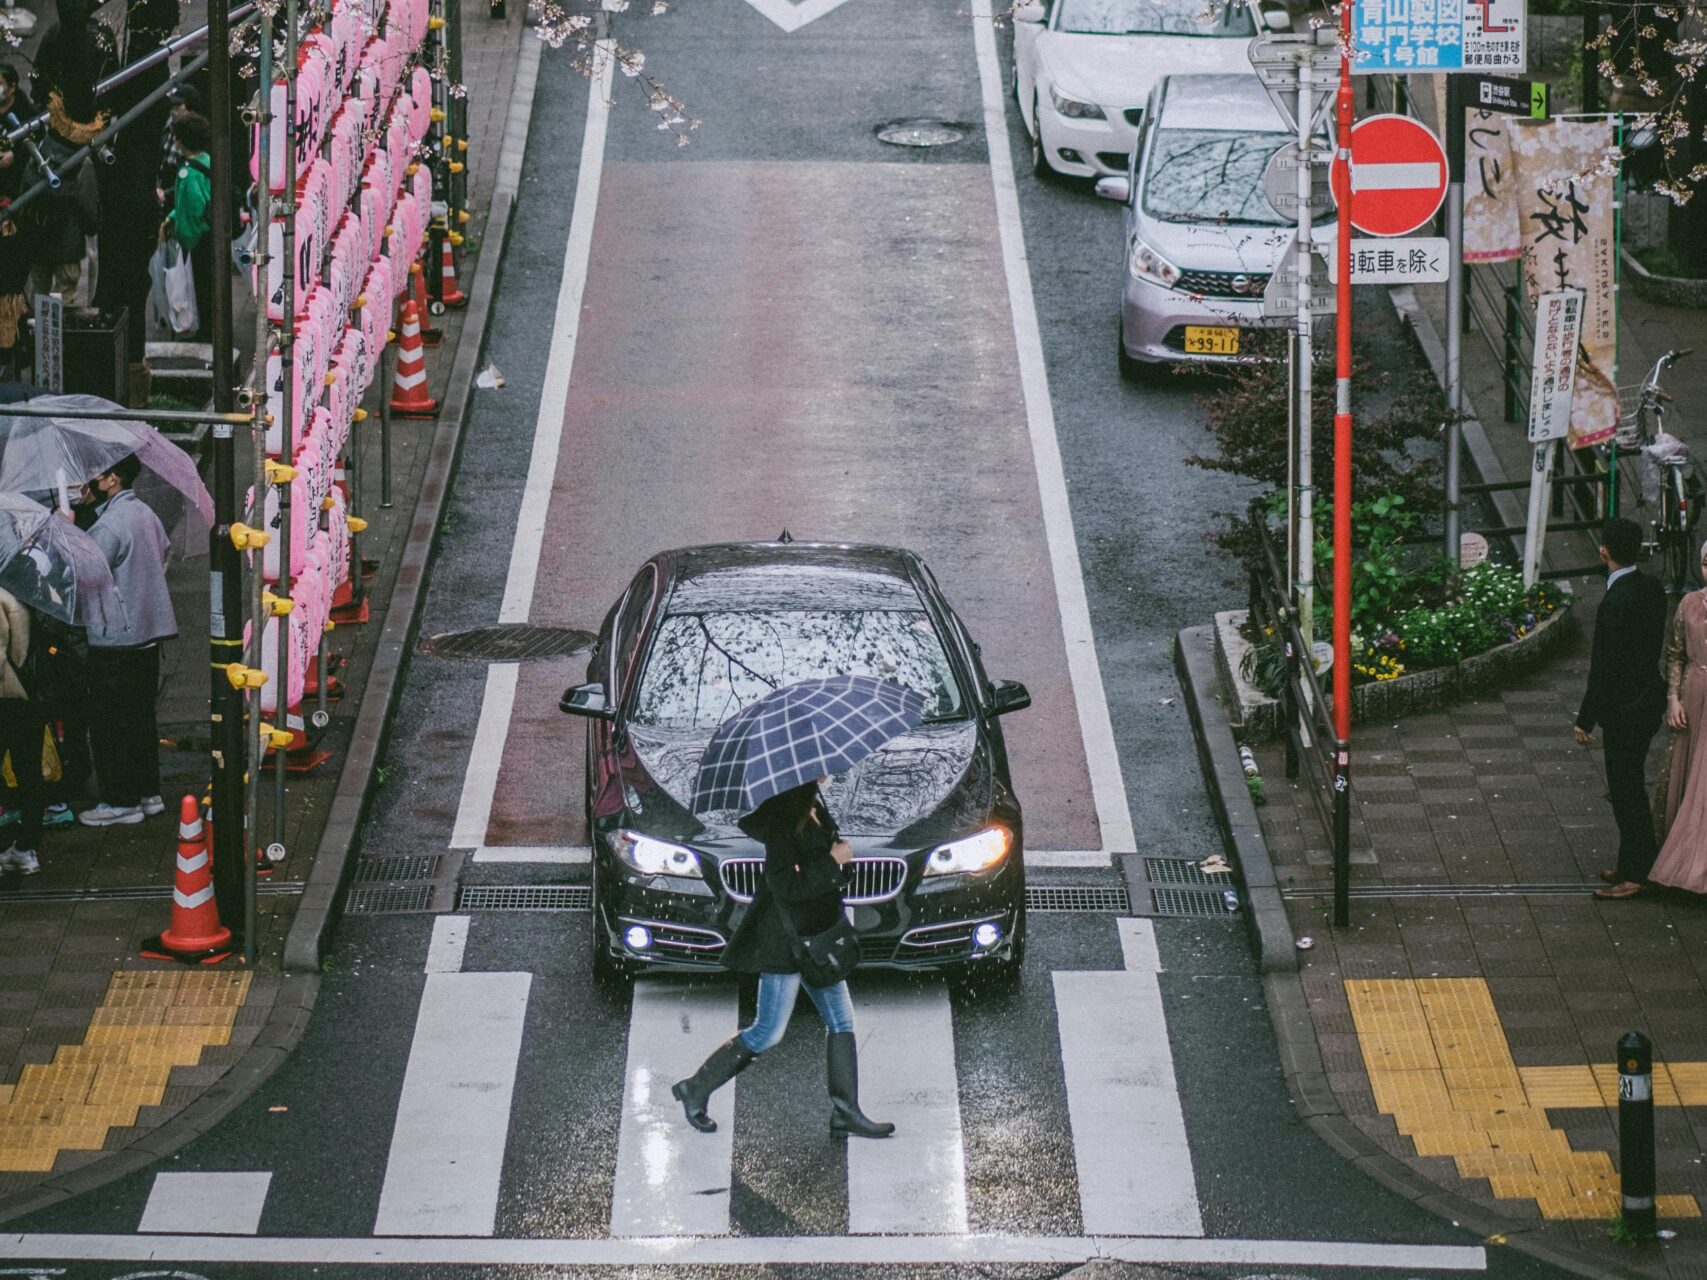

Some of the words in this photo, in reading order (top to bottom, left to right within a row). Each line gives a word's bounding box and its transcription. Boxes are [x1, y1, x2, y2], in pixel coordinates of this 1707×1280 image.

[1360, 26, 1461, 46] 専門学校
[1383, 46, 1439, 66] 1号館
